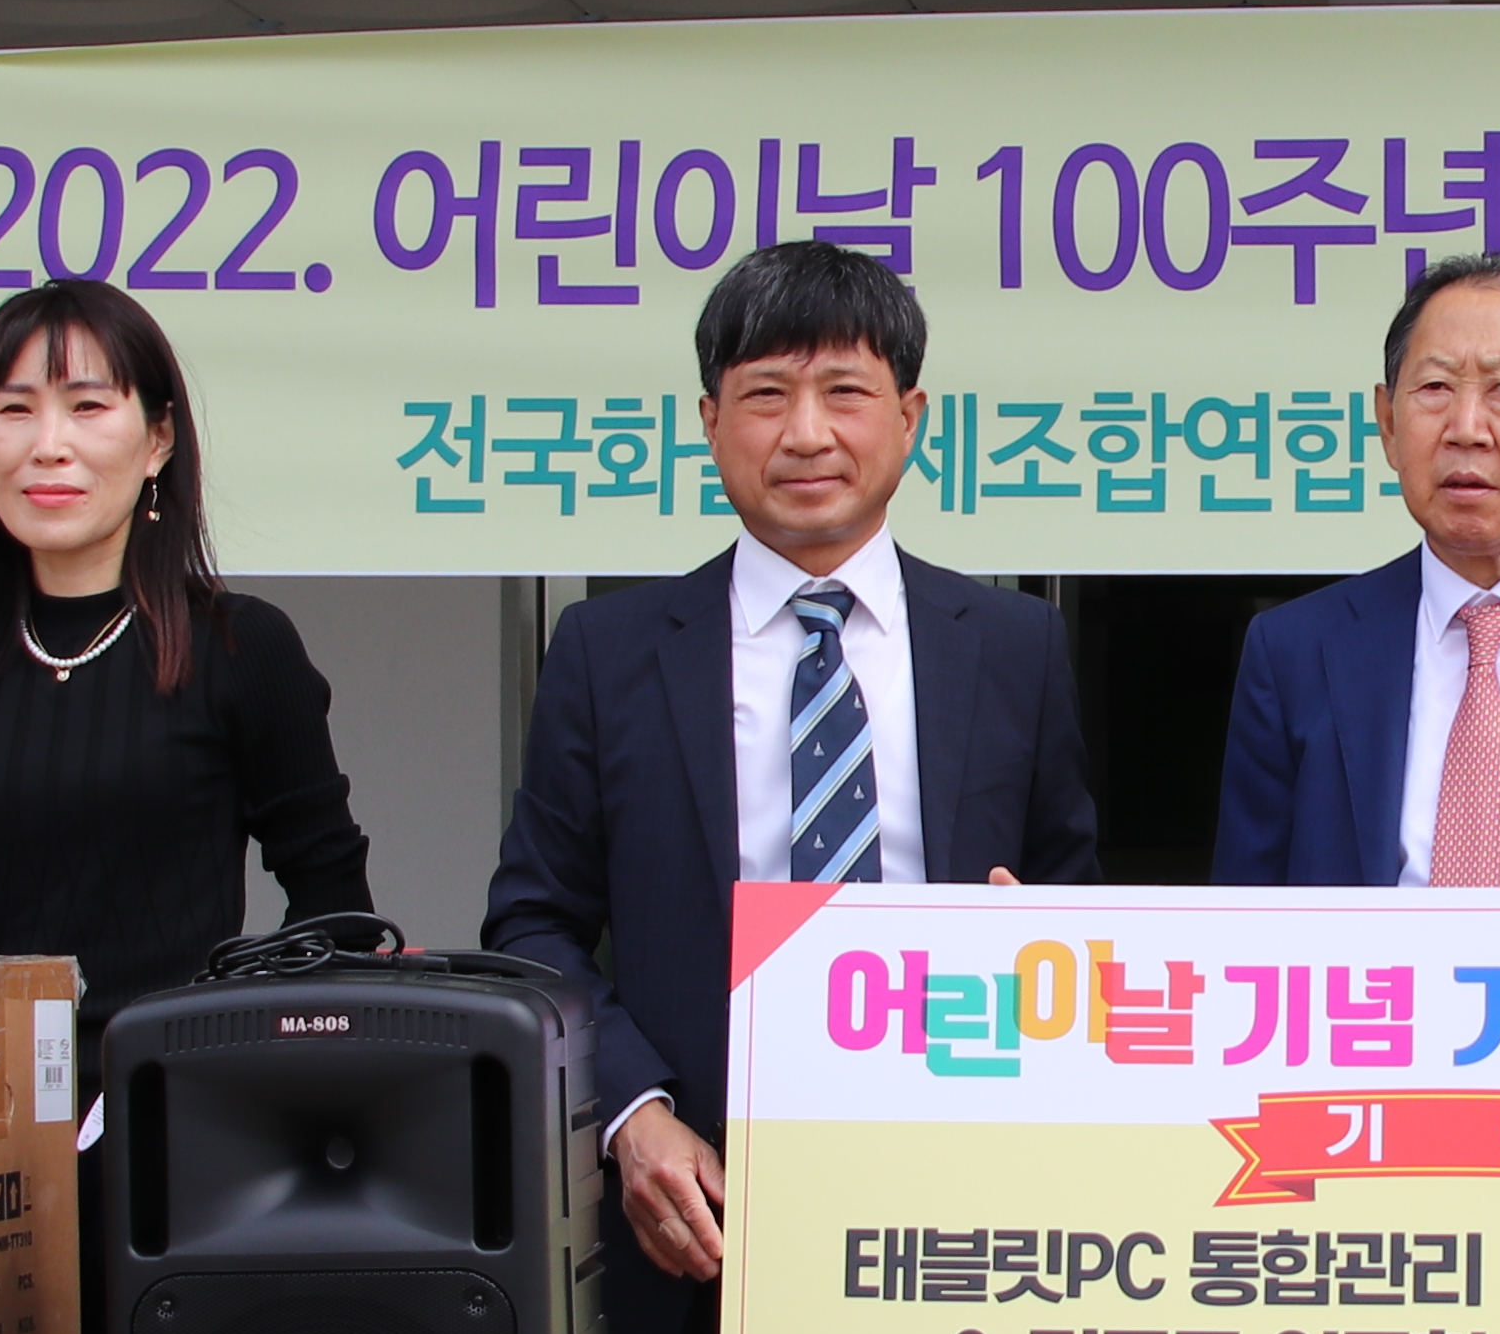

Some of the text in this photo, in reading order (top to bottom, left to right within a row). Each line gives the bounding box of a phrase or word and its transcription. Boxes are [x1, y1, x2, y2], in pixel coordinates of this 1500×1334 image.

[373, 135, 936, 307] 어린이날
[280, 1014, 351, 1034] MA-808
[827, 940, 1204, 1078] 어린이날
[1222, 961, 1415, 1067] 기념
[843, 1229, 1165, 1301] 태블릿PC
[1190, 1229, 1483, 1306] 통합관리
